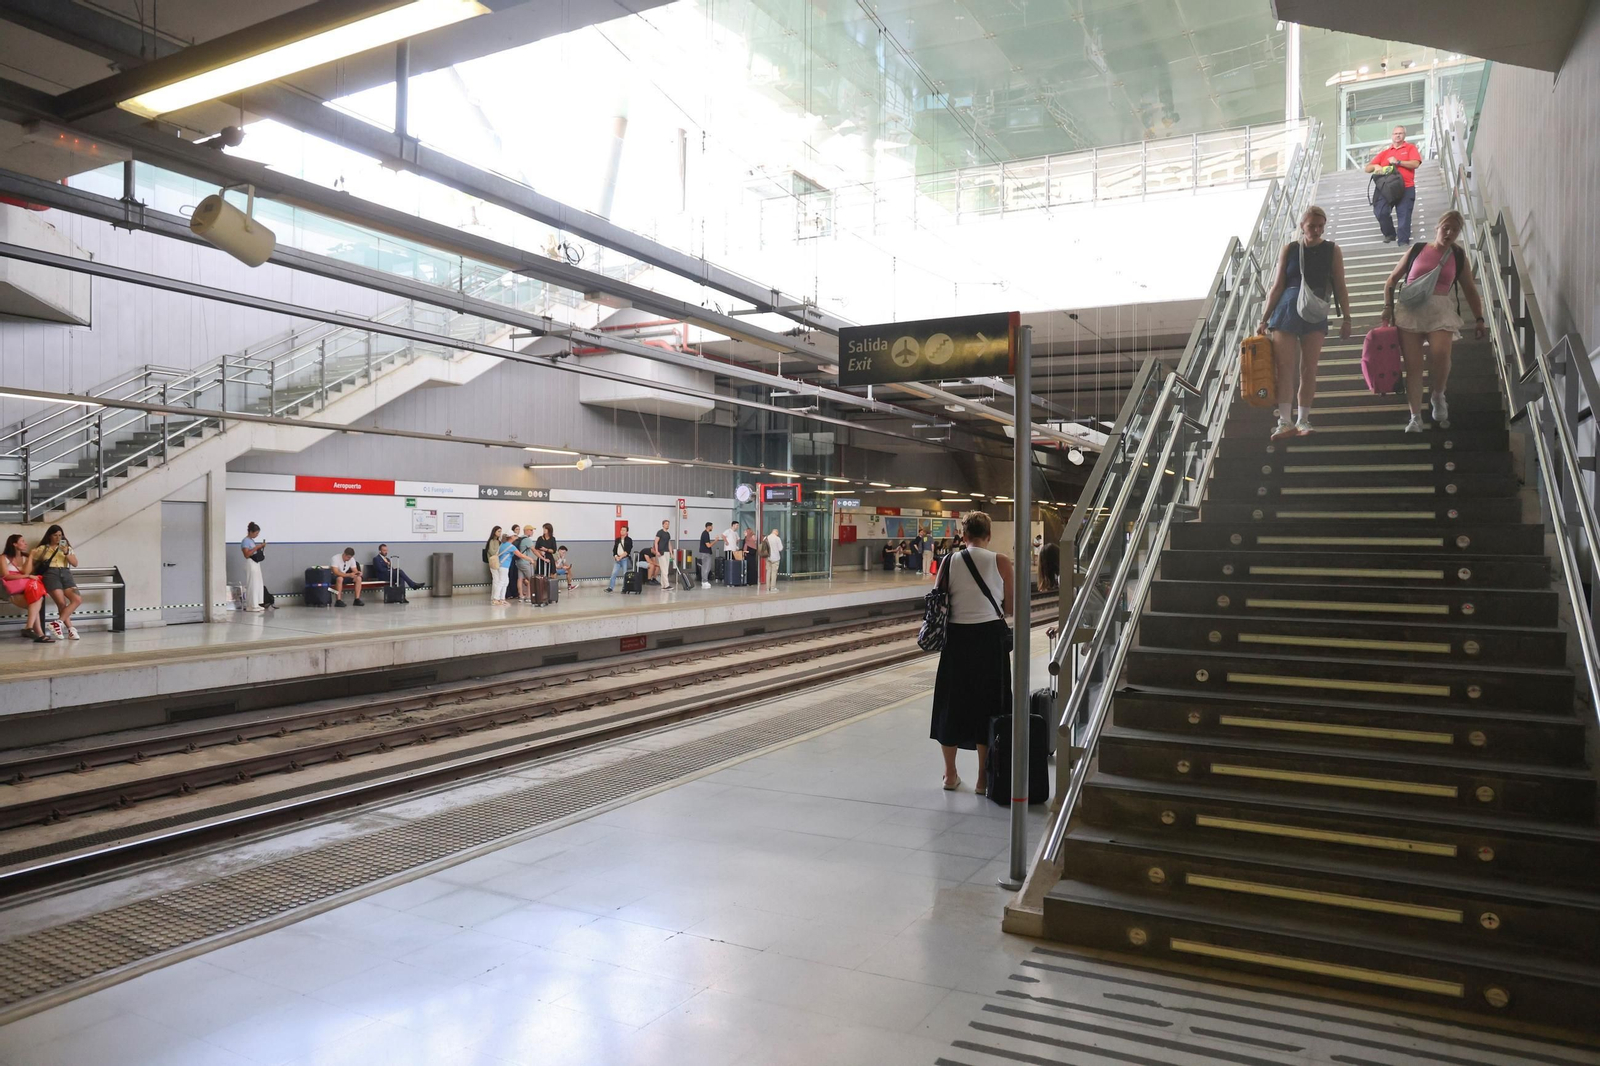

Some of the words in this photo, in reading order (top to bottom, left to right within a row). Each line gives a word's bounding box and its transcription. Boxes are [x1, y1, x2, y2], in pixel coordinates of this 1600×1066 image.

[848, 337, 888, 354] Salida
[848, 356, 872, 371] Exit
[333, 482, 361, 491] Aeropuerto
